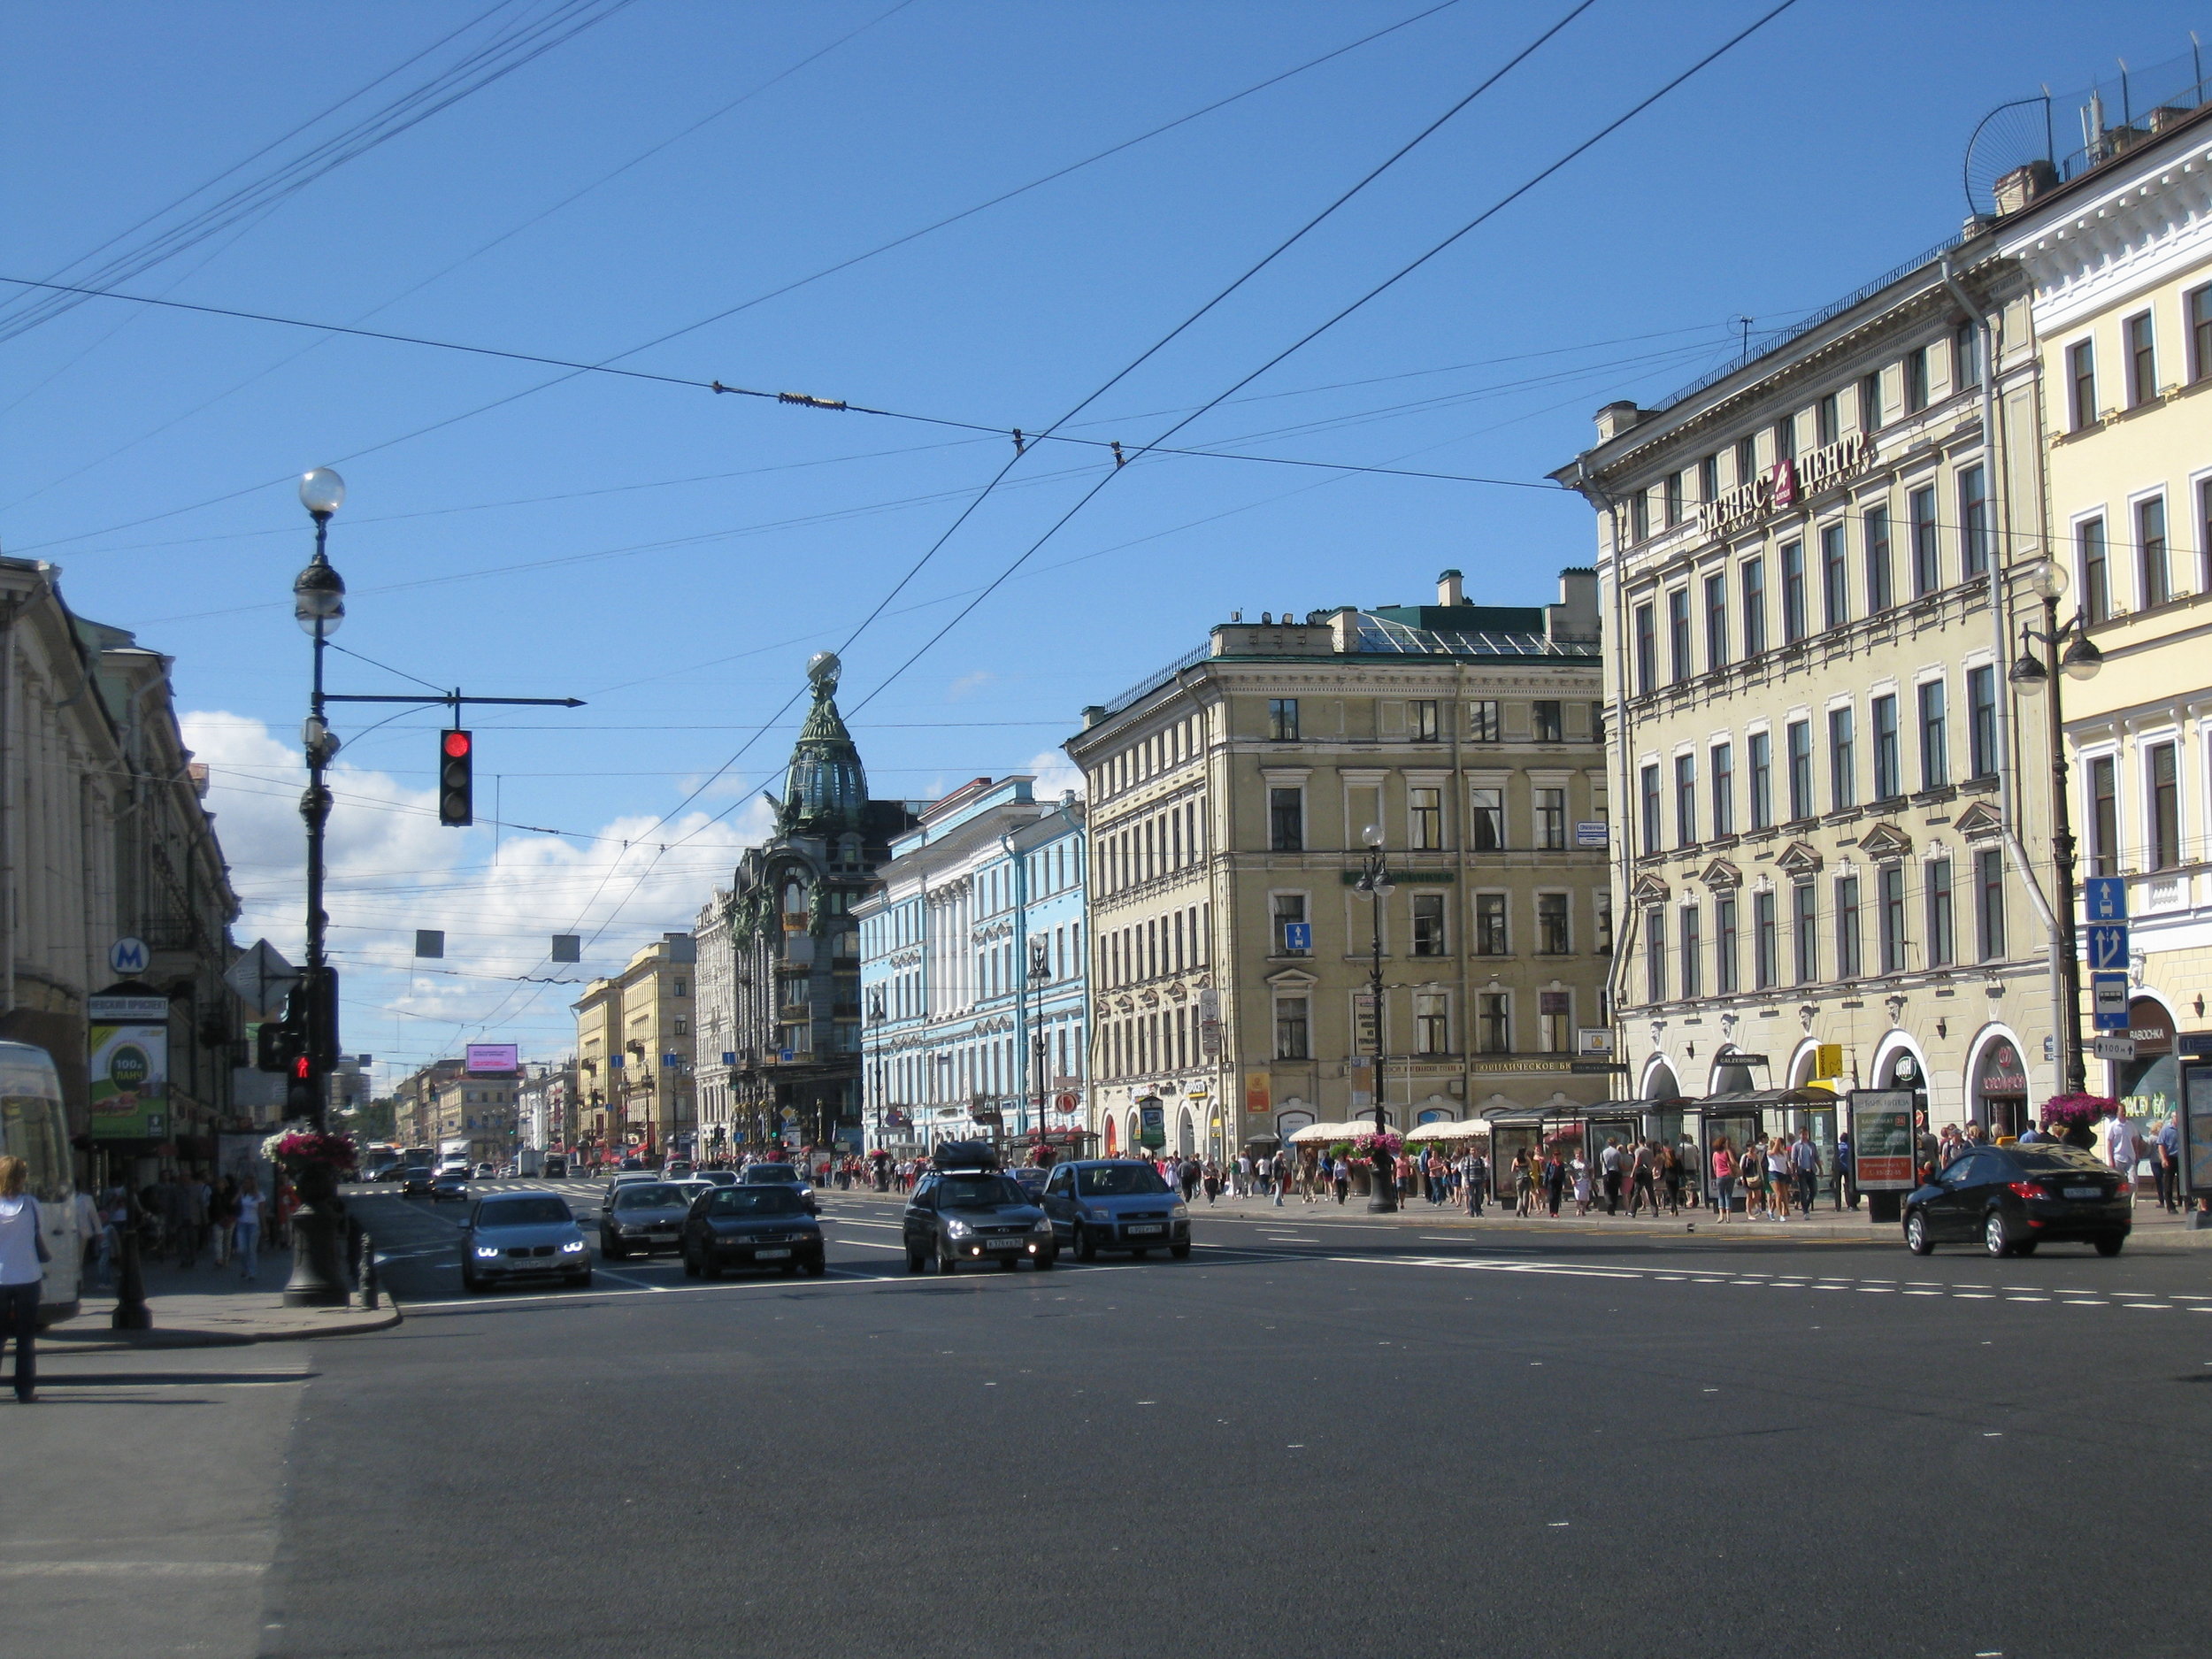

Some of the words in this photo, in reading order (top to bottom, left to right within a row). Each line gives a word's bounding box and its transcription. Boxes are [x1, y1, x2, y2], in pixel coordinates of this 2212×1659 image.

[1696, 478, 1768, 535] БИЗНЕС
[1799, 432, 1864, 490] ЦЕНТР
[2105, 1044, 2120, 1053] 100
[116, 1059, 137, 1070] 100
[1479, 1063, 1555, 1071] ЮРИДИЧЕСКОЕ
[1895, 1057, 1912, 1077] LUSH
[117, 1071, 143, 1080] ЛАНЧ
